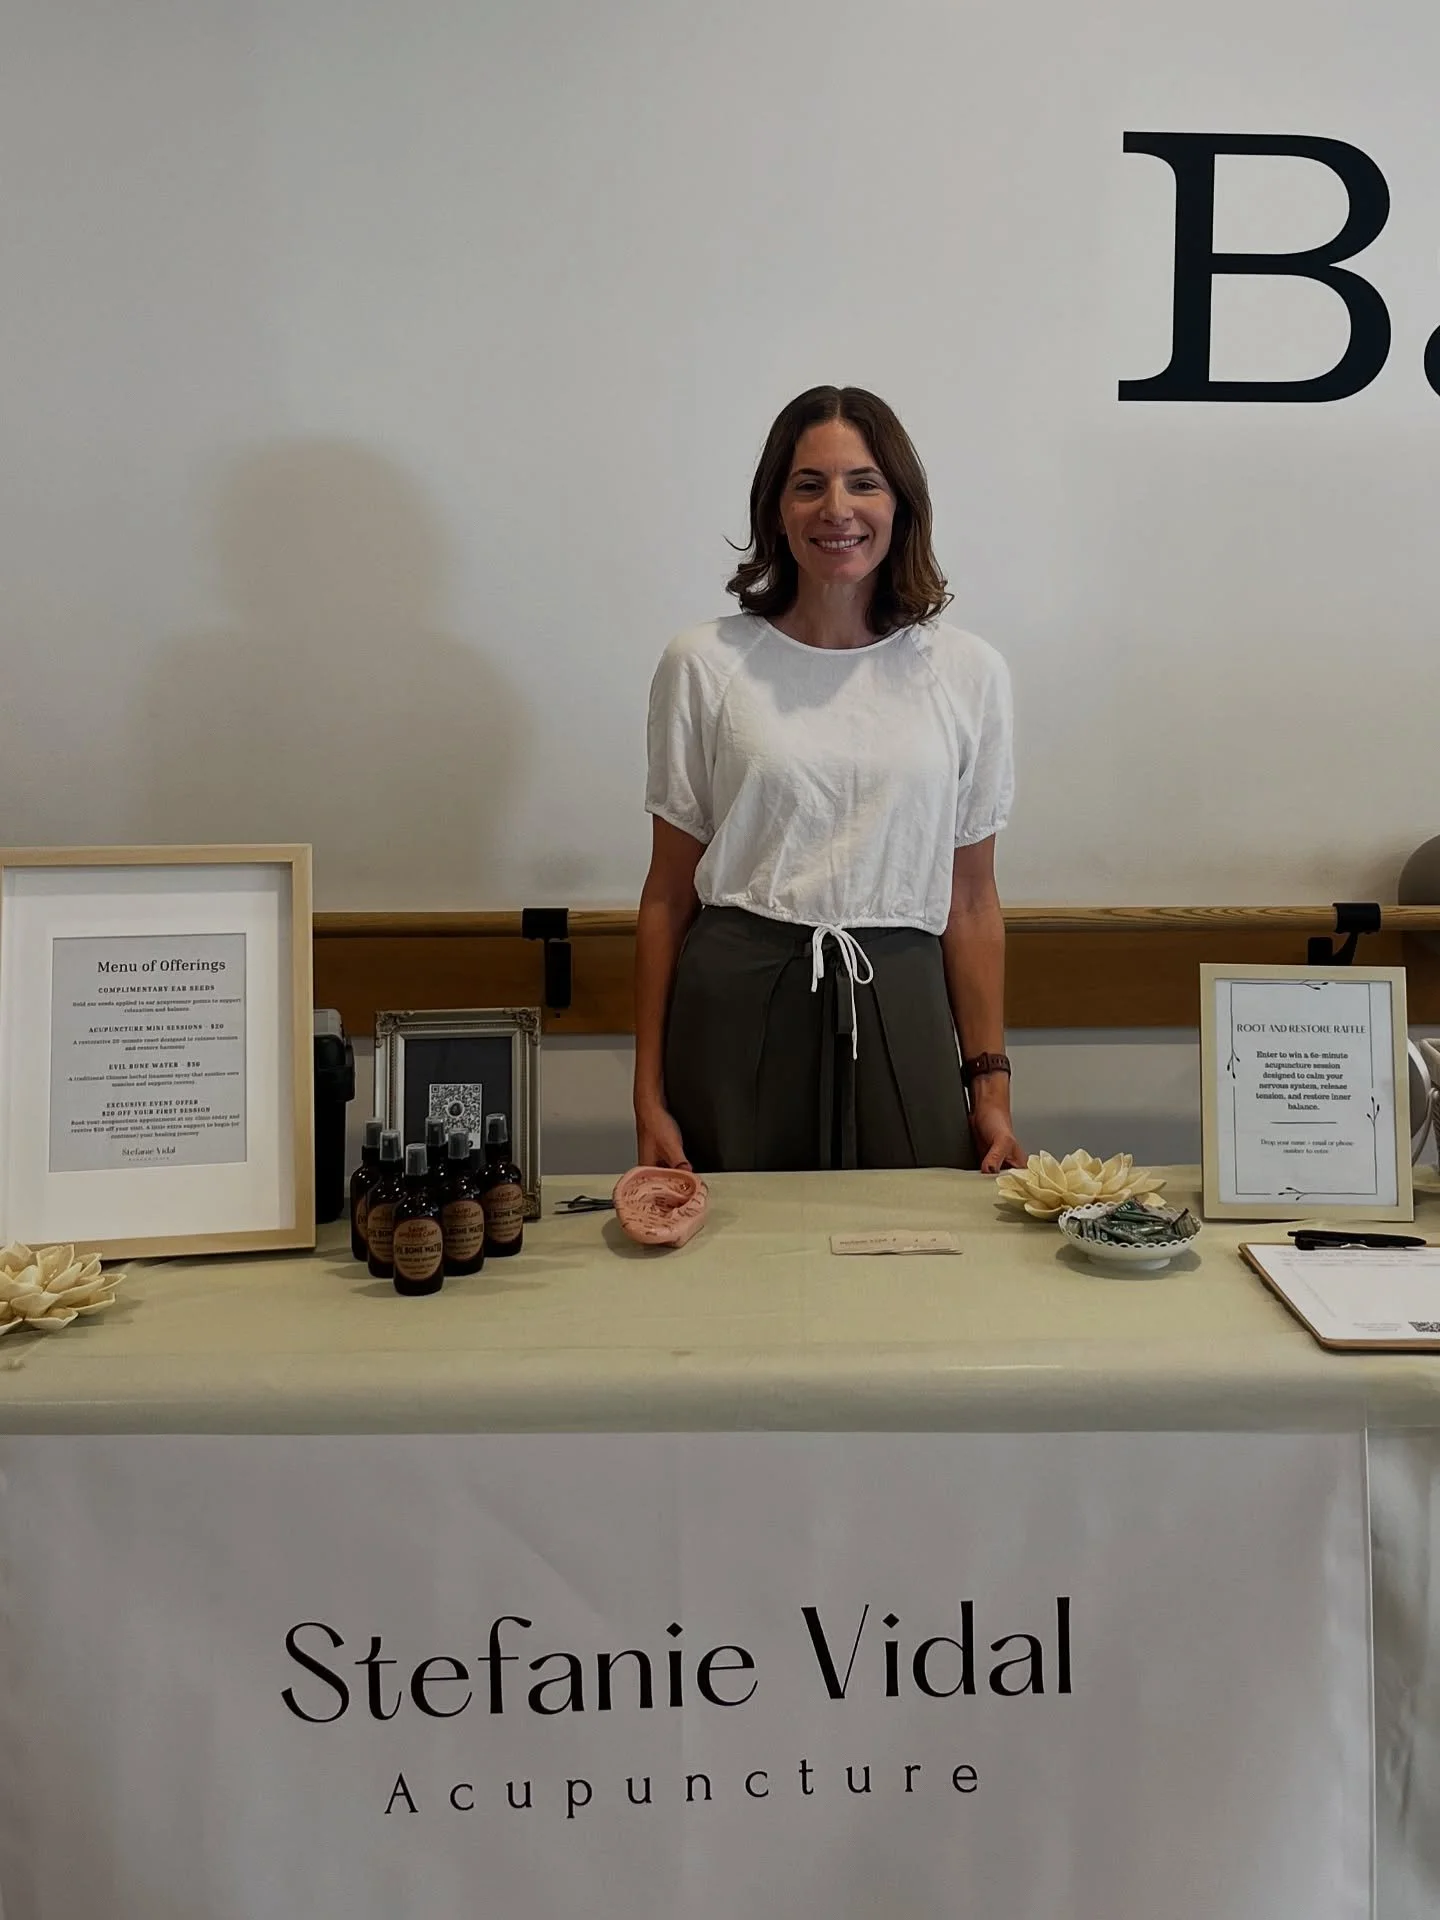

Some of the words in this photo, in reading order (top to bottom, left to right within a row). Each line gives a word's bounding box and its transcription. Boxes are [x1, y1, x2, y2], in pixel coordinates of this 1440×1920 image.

[1118, 131, 1440, 403] B
[98, 962, 137, 972] Menu
[142, 960, 157, 972] of
[160, 959, 225, 973] Offerings
[116, 1000, 137, 1008] applied
[1237, 1024, 1265, 1032] ROOT
[1289, 1024, 1331, 1033] RESTORE
[1334, 1025, 1366, 1033] RAFFLE
[1265, 1062, 1311, 1070] acupuncture
[1263, 1072, 1296, 1080] designed
[1290, 1083, 1319, 1091] system,
[1256, 1092, 1286, 1100] tension,
[102, 1118, 138, 1126] acupuncture
[139, 1116, 176, 1125] appointment
[122, 1148, 154, 1156] Stefanie
[157, 1146, 175, 1154] Vidal
[281, 1616, 758, 1723] Stefanie
[801, 1597, 1071, 1699] Vidal
[384, 1759, 977, 1819] Acupuncture
